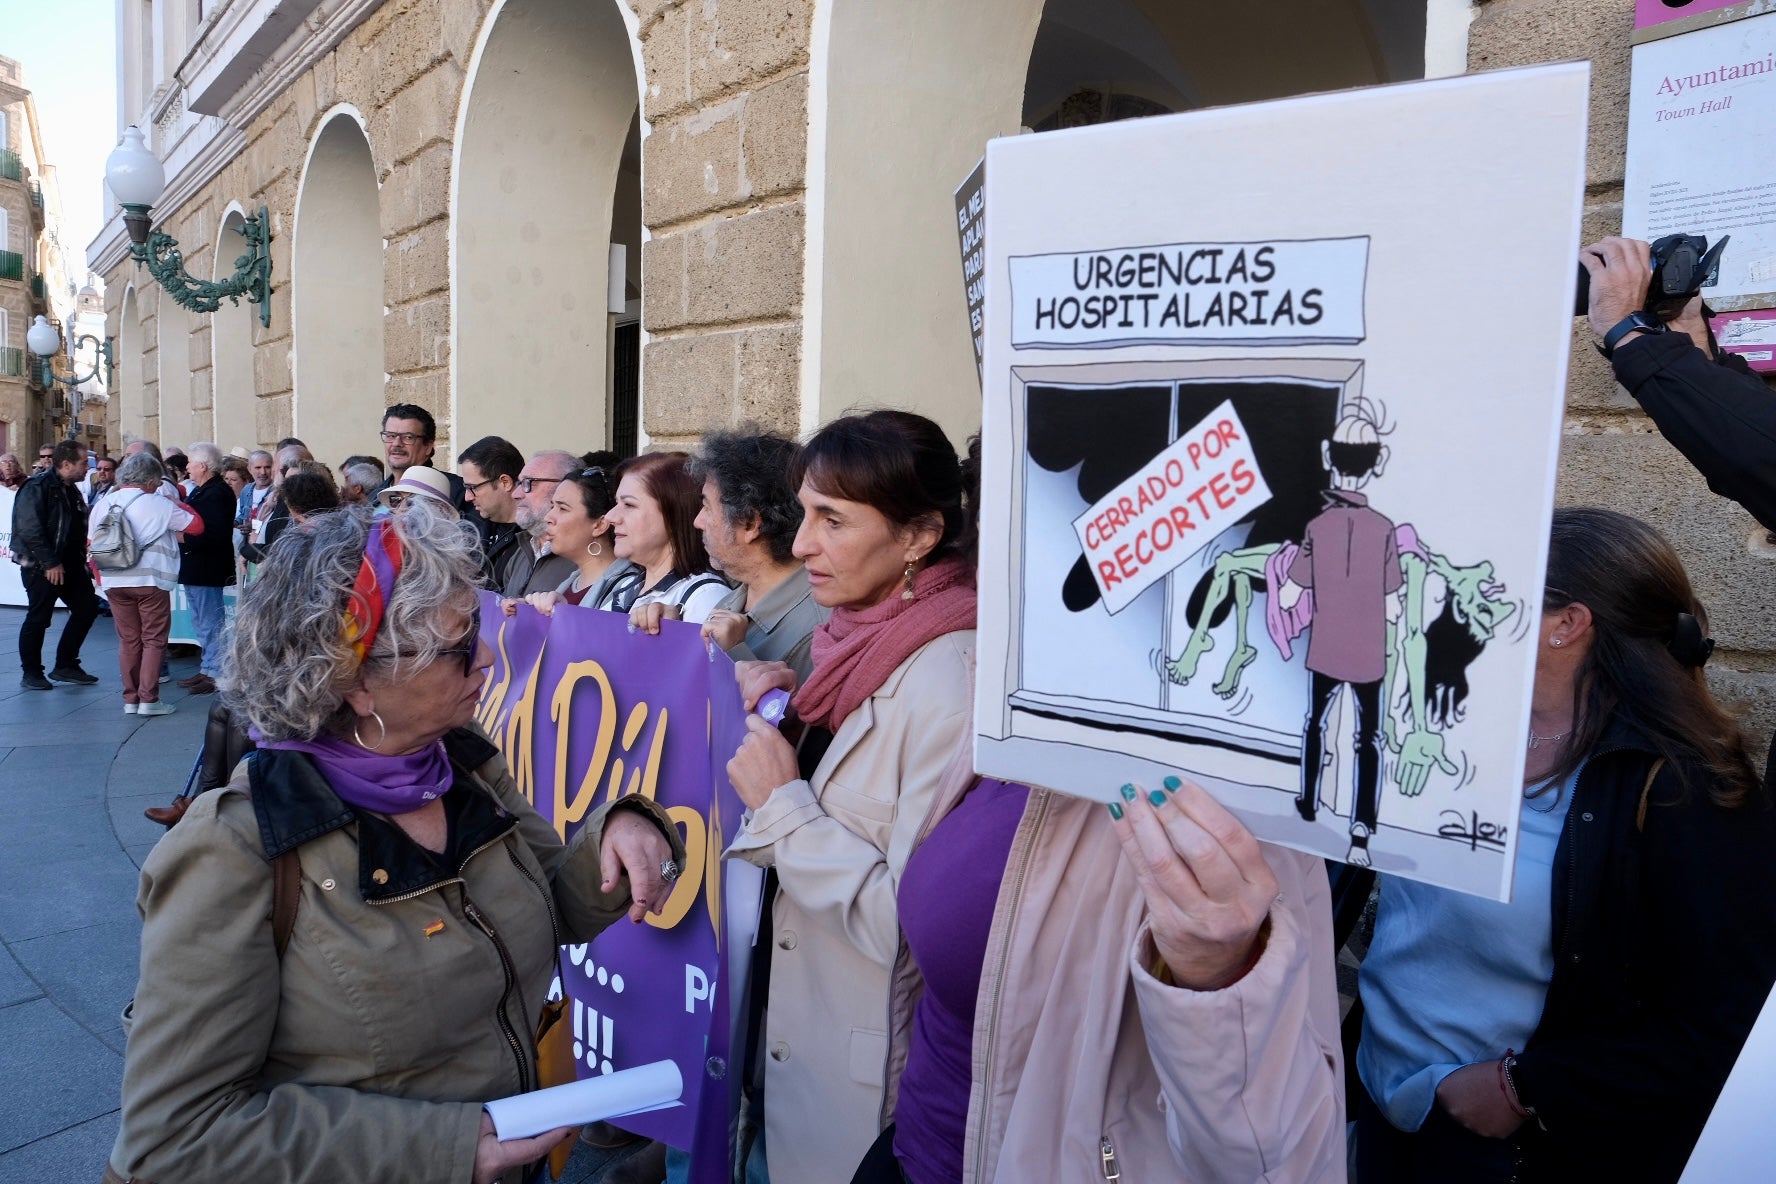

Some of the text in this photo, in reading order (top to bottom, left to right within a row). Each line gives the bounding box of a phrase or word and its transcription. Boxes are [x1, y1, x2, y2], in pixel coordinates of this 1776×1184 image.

[1656, 52, 1776, 97] Ayuntami
[1656, 96, 1732, 122] Town Hall
[959, 207, 969, 231] EL
[1074, 246, 1276, 291] URGENCIAS
[1036, 288, 1323, 330] HOSPITALARIAS
[1085, 419, 1240, 550] CERRADO POR
[1098, 458, 1255, 592] RECORTES
